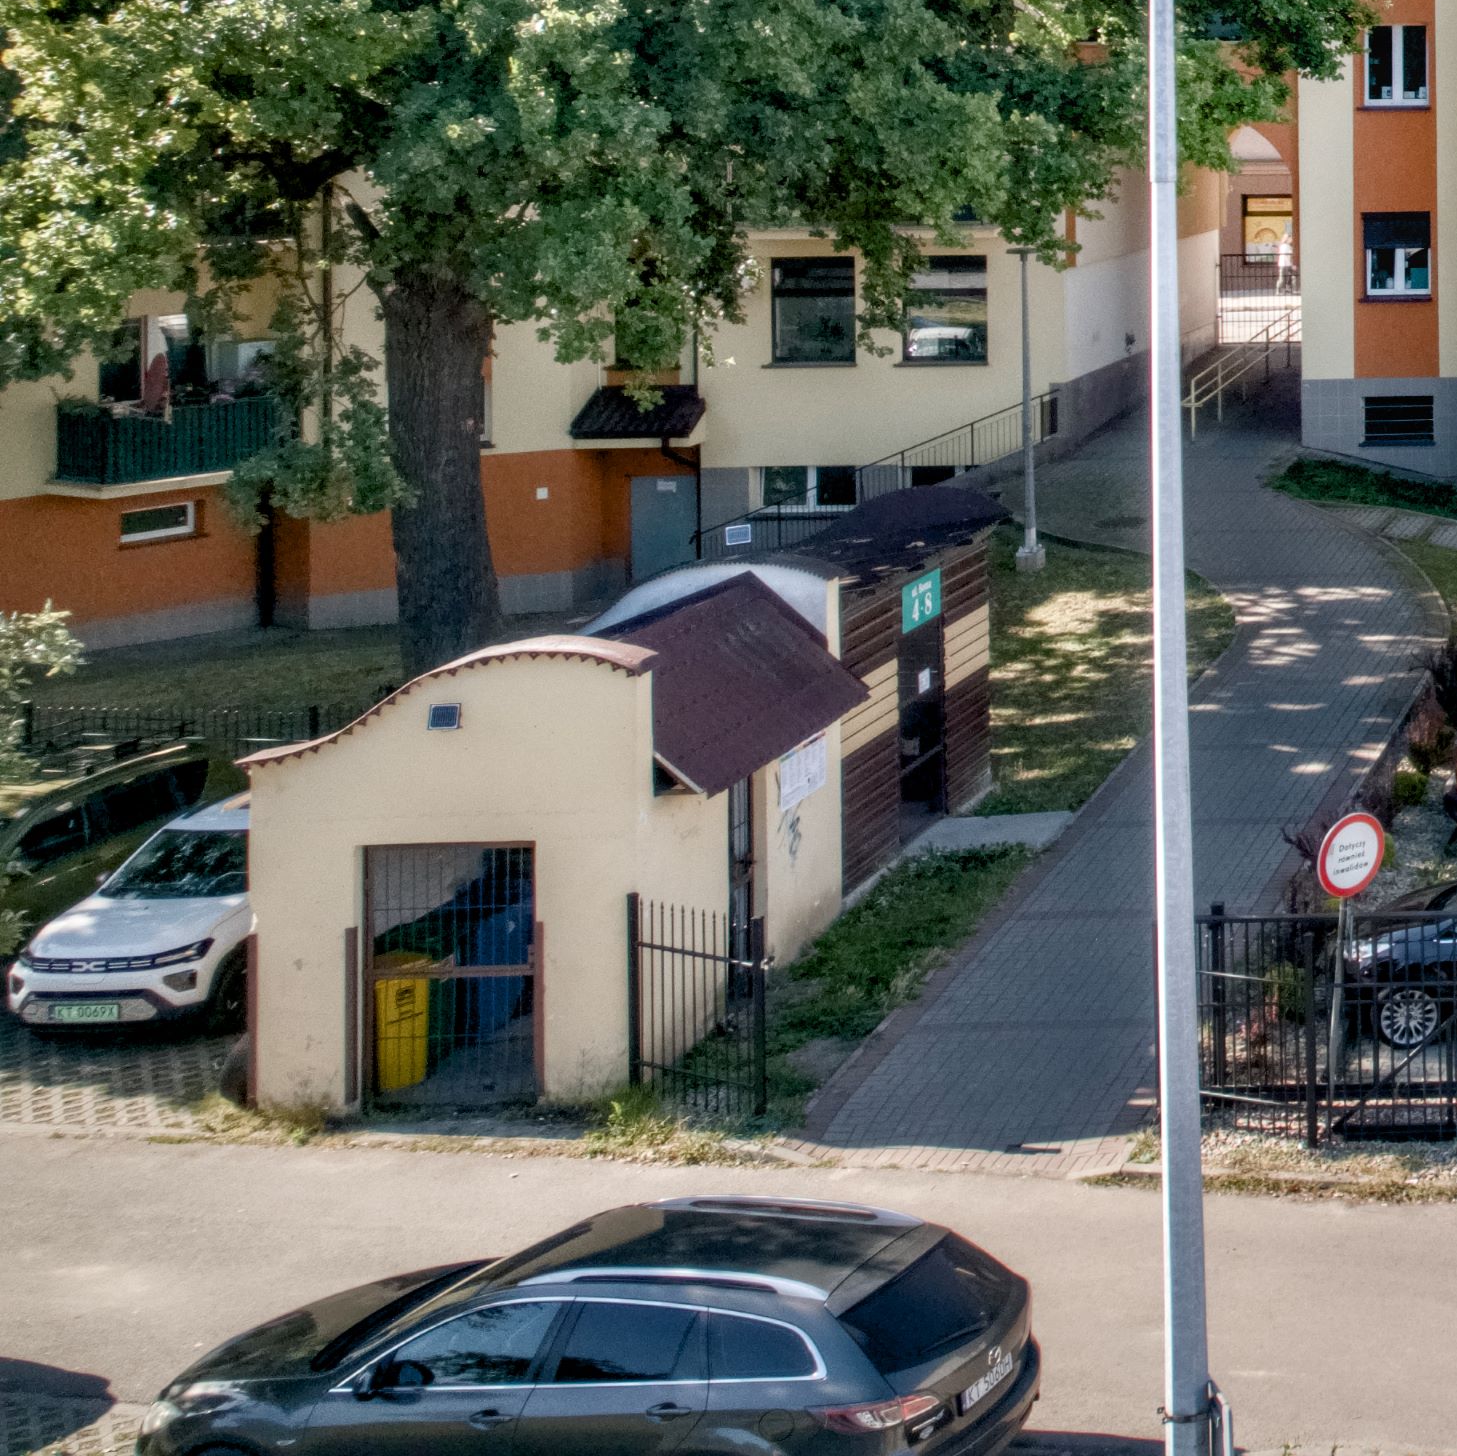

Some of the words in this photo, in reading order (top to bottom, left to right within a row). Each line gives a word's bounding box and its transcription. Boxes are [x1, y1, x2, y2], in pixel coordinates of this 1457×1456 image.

[58, 1006, 73, 1018] KT
[78, 1006, 114, 1018] 0069X
[967, 1382, 981, 1404] KT
